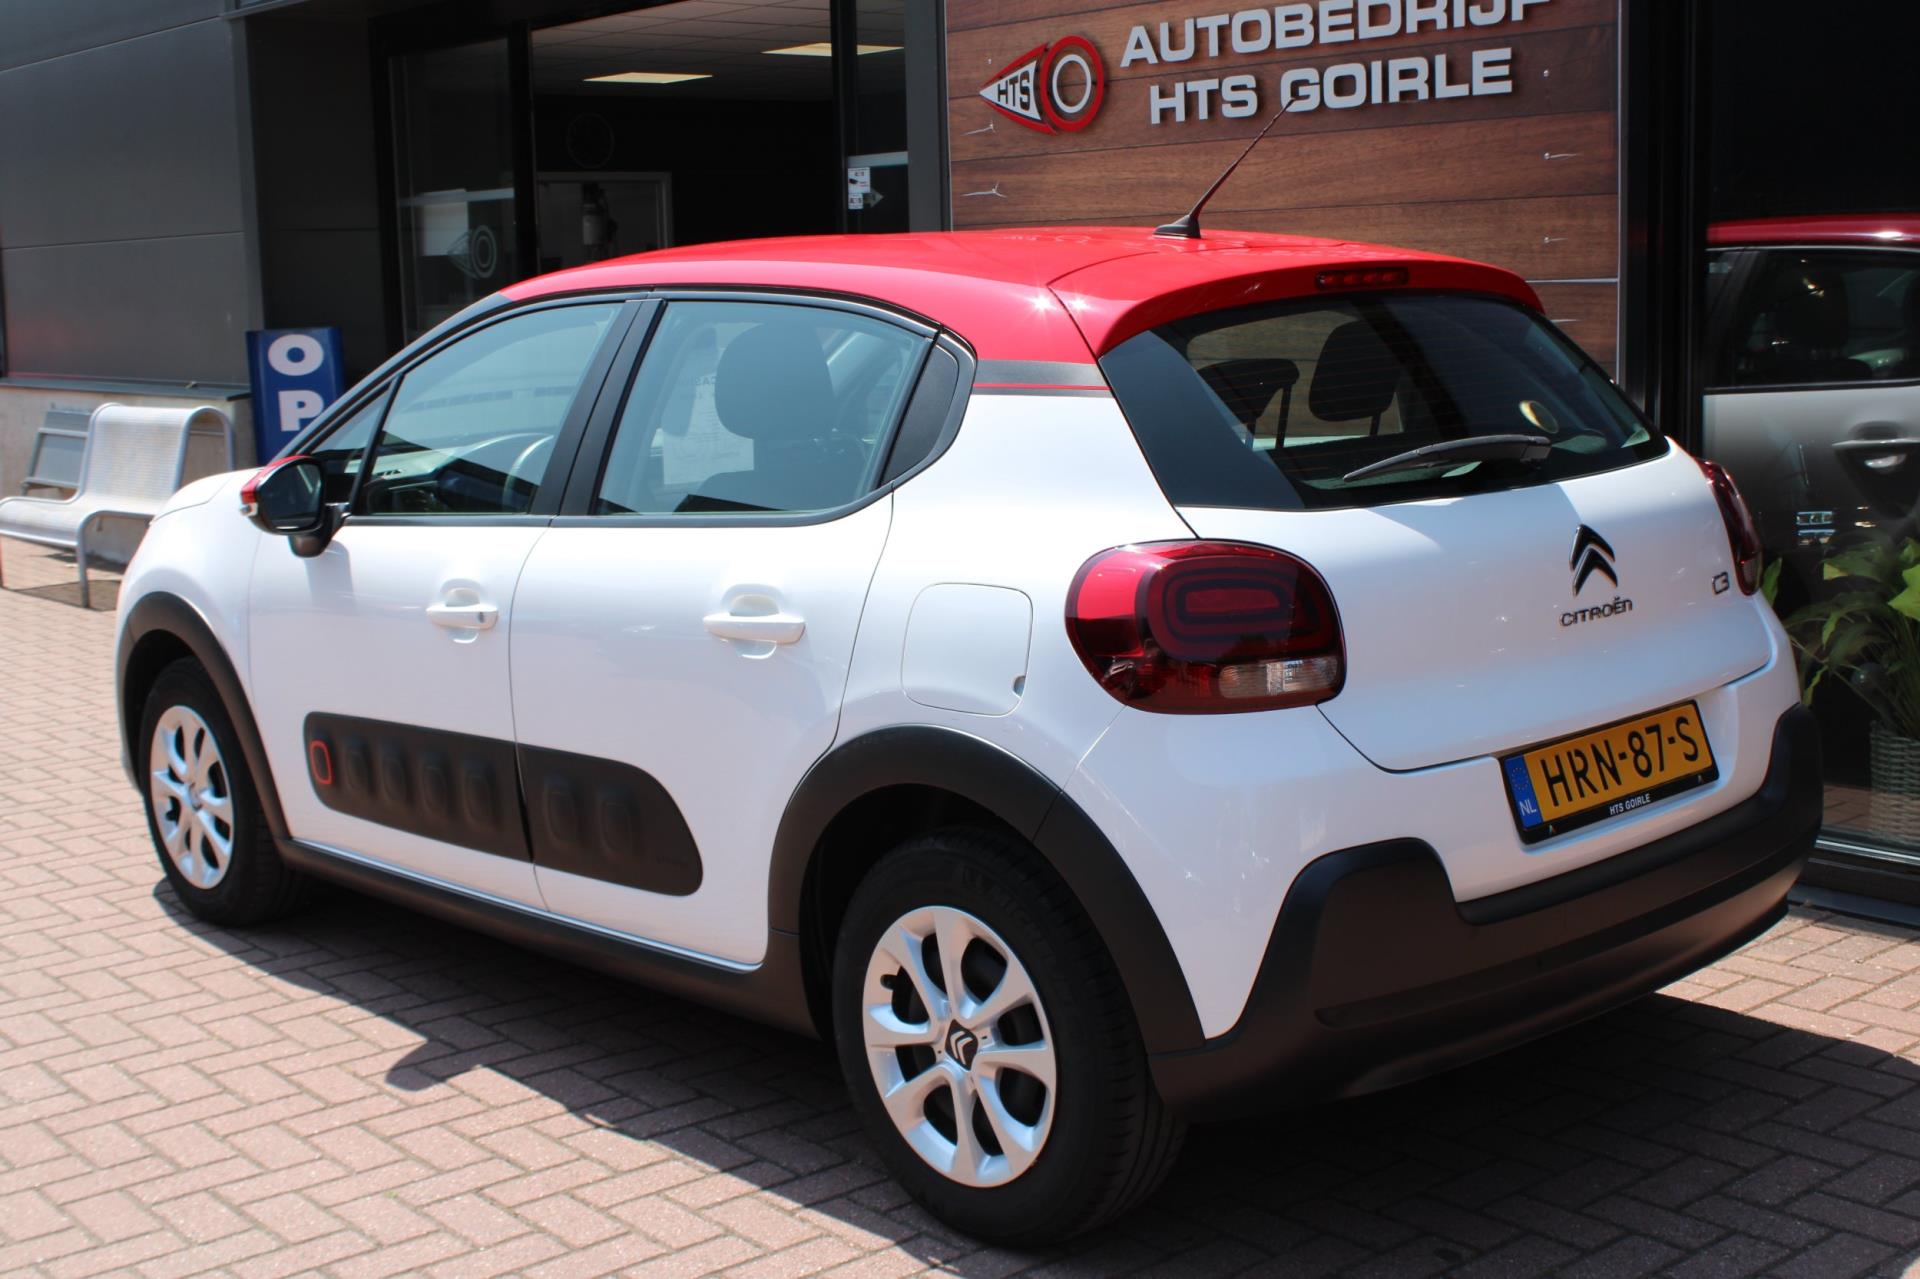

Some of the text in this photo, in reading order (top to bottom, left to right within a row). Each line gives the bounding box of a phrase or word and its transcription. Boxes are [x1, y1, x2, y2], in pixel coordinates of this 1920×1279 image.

[998, 70, 1030, 111] HTS
[1150, 47, 1513, 125] HTS GOIRLE
[1540, 716, 1699, 807] HRN-87-S
[1519, 798, 1537, 816] NL
[1610, 793, 1651, 815] HTS GOIRLE
